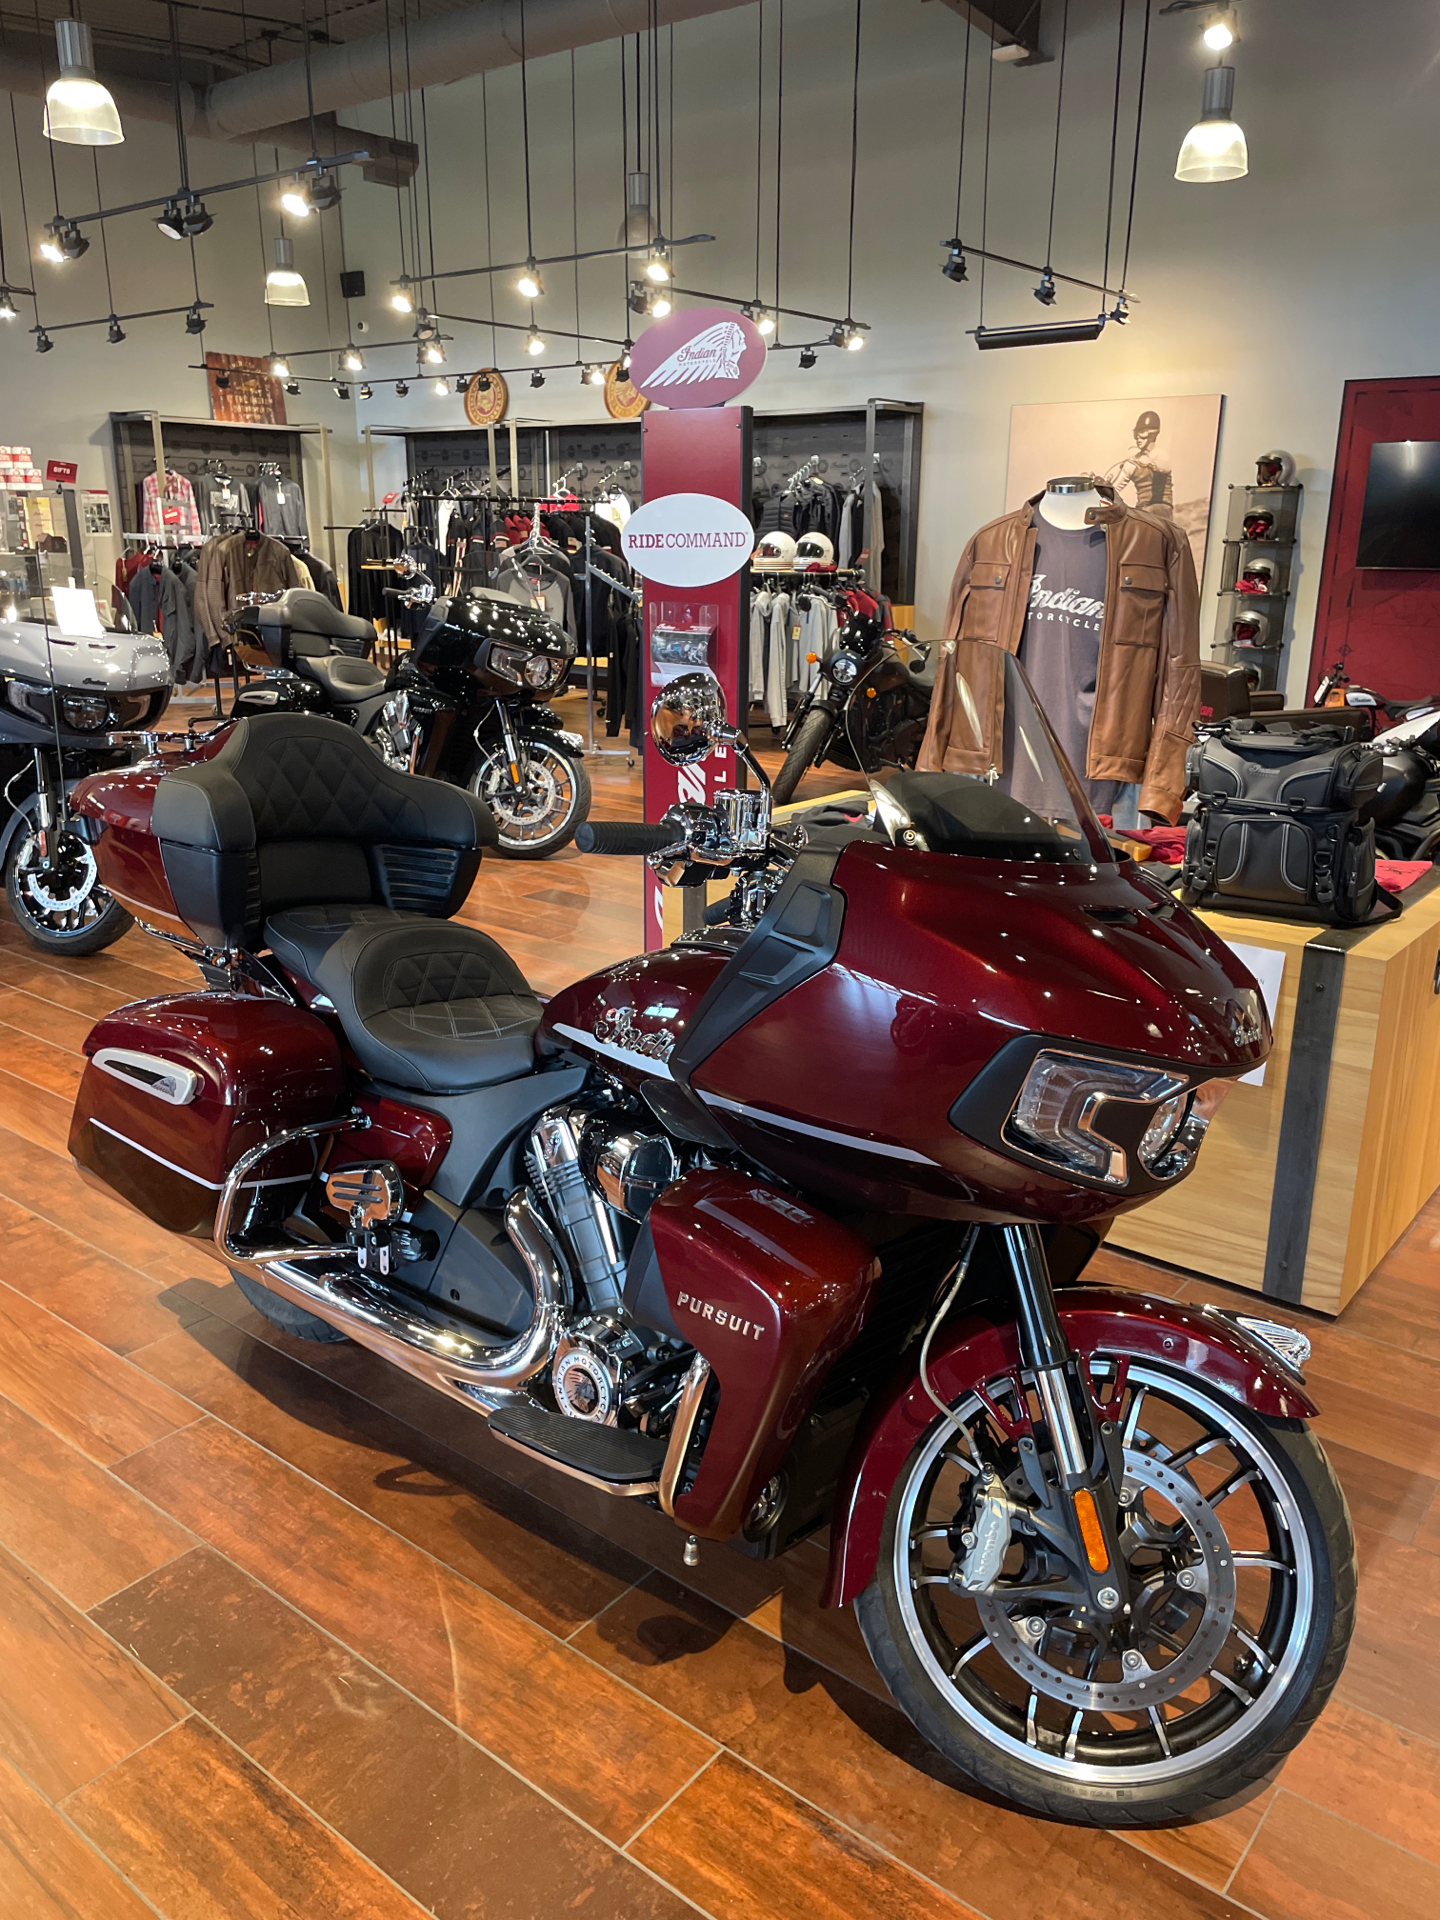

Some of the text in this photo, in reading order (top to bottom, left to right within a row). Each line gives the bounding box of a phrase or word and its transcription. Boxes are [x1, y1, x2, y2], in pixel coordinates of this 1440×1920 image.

[677, 345, 717, 362] Indian
[53, 466, 71, 475] GIFTS
[1030, 573, 1105, 619] Indian
[1027, 611, 1101, 631] TORCYCLE
[676, 1291, 765, 1341] PURSUIT
[974, 1520, 1000, 1576] brembo
